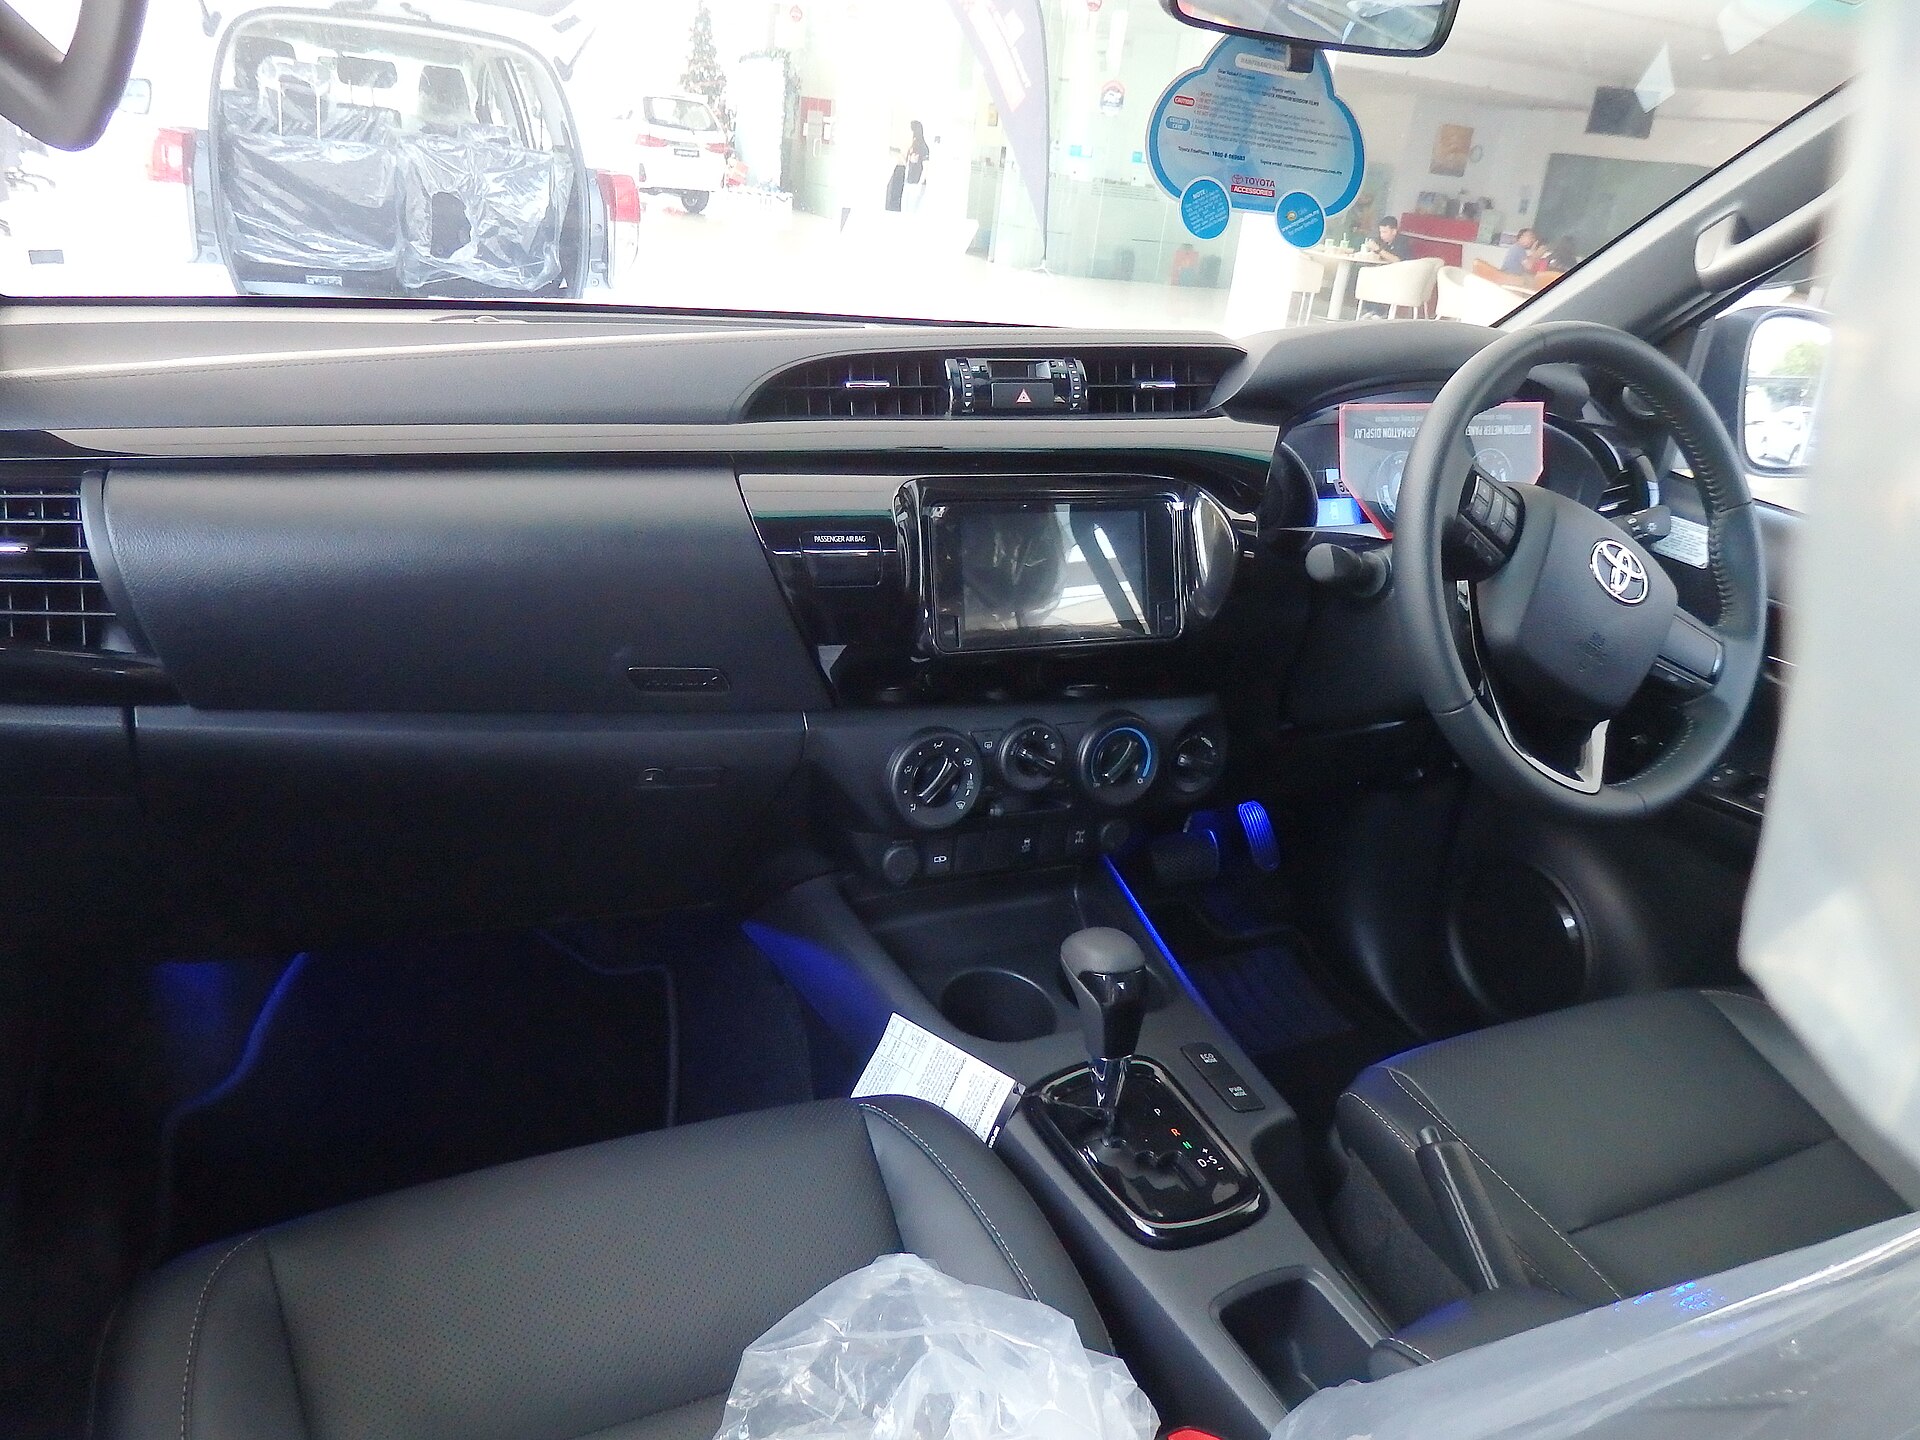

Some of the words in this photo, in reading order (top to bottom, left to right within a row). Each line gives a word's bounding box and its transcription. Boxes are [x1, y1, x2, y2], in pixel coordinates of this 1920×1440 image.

[1244, 176, 1275, 188] TOYOTA
[1233, 186, 1273, 197] ACCESSORIES
[1353, 428, 1382, 439] DISPLAY
[1484, 425, 1503, 436] METER
[814, 535, 845, 543] PASSENGER
[846, 535, 854, 543] AIR
[855, 535, 866, 543] BAG
[1153, 1107, 1161, 1116] P
[1171, 1128, 1181, 1137] R
[1182, 1140, 1193, 1150] N
